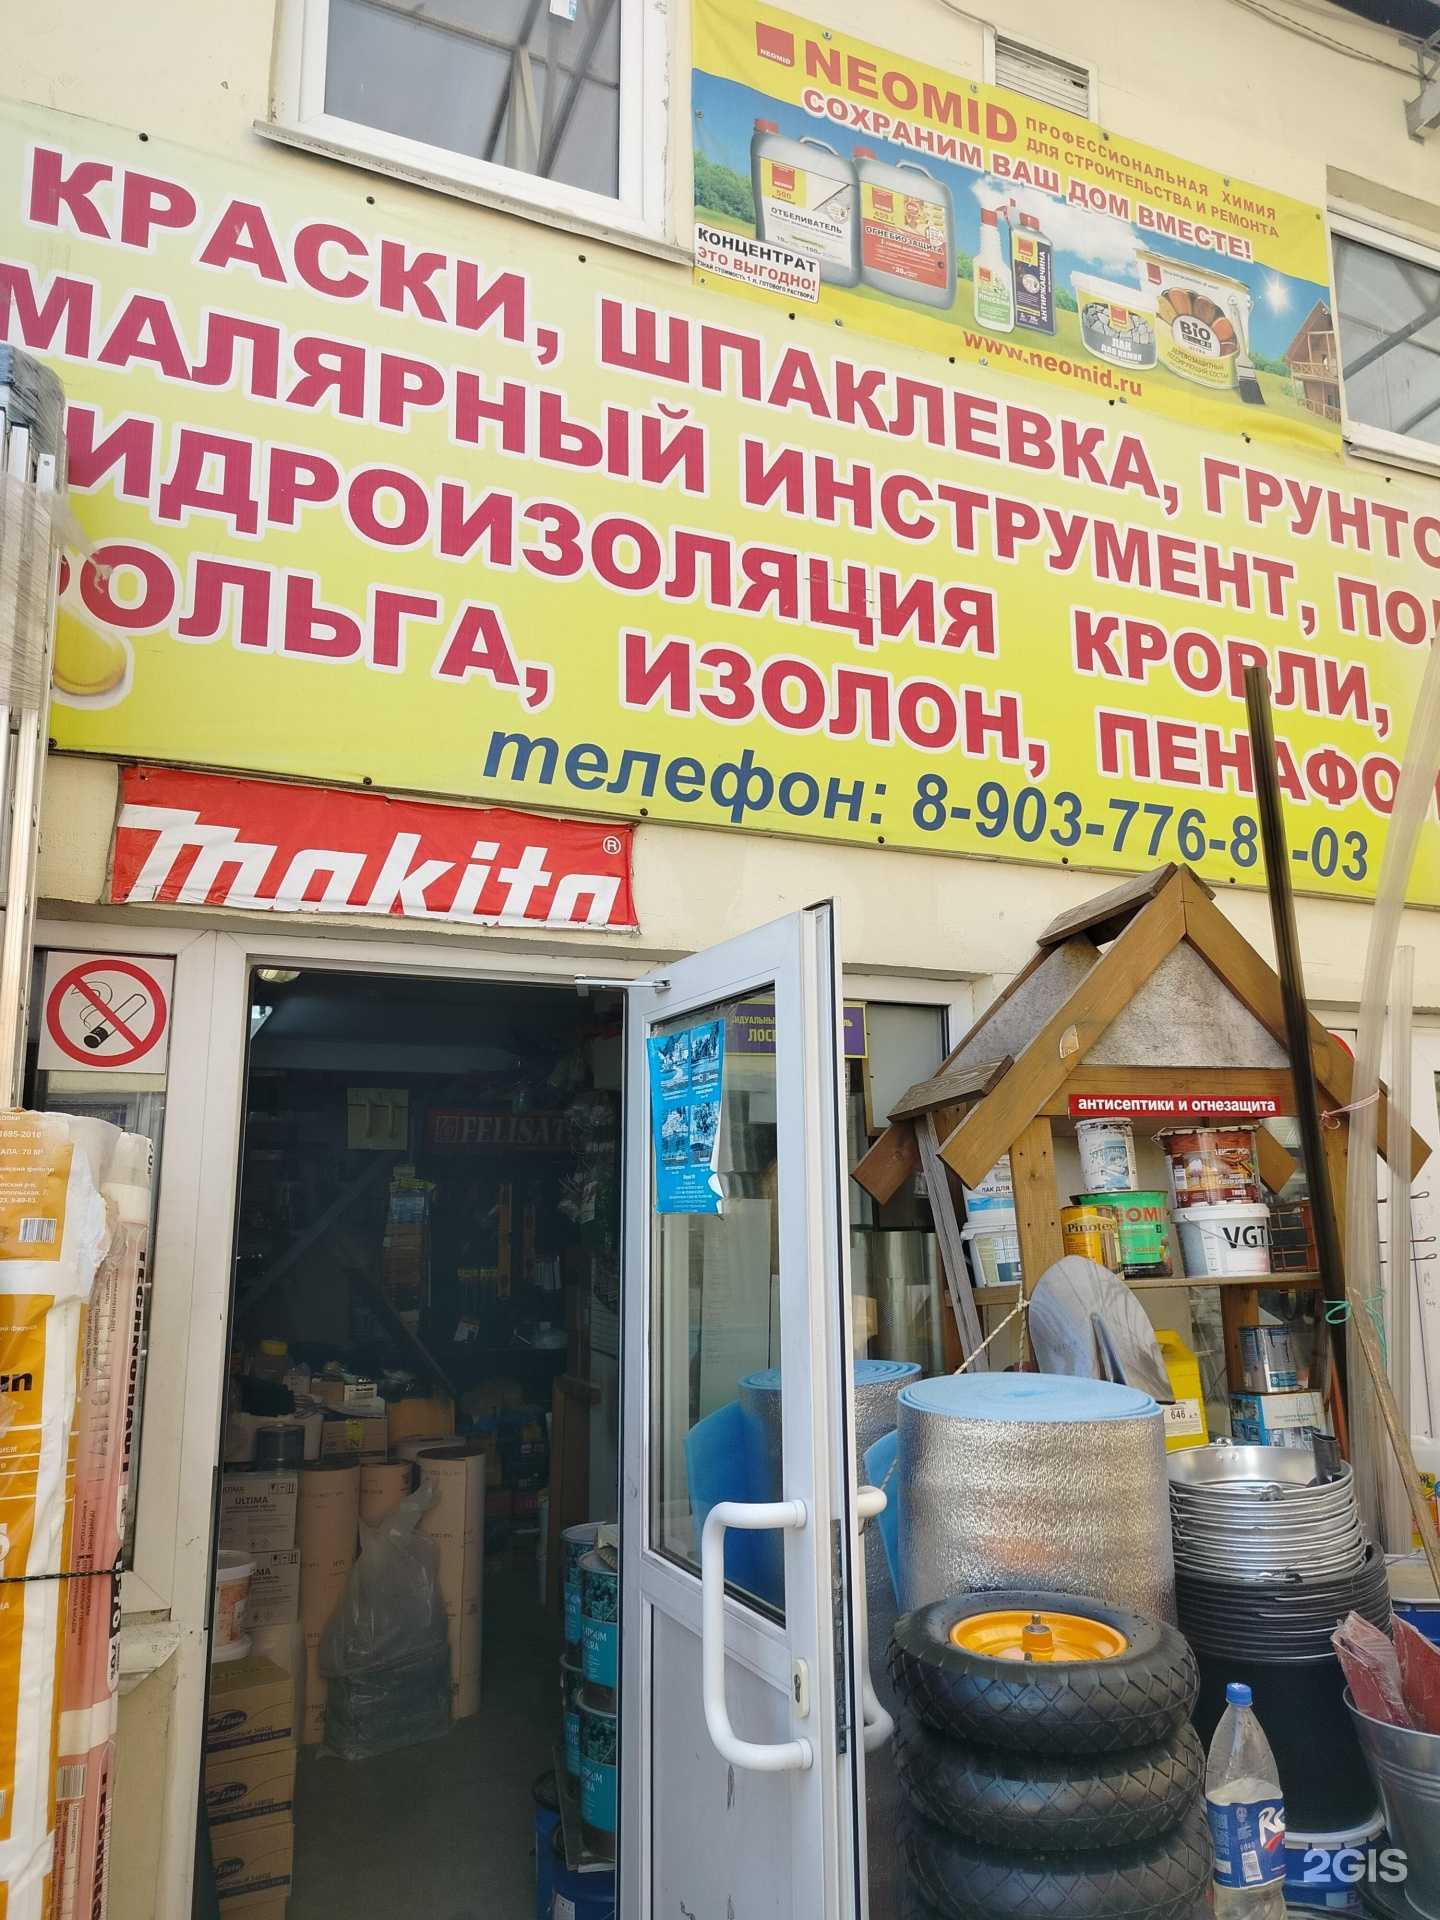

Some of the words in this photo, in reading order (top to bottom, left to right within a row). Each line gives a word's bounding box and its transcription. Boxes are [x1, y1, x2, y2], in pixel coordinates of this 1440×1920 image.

[804, 39, 1018, 144] NEOMID
[803, 89, 982, 169] СОХРАНИМ
[992, 153, 1060, 195] ВАШ
[1068, 179, 1130, 220] ДОМ
[1138, 204, 1252, 260] ВМЕСТЕ!
[1026, 116, 1209, 197] ПРОФЕССИОНАЛЬНАЯ
[1221, 190, 1277, 221] ХИМИЯ
[1026, 137, 1059, 161] ДЛЯ
[1064, 151, 1192, 210] СТРОИТЕЛЬСТВА
[1195, 202, 1206, 215] И
[1211, 205, 1280, 238] РЕМОНТА
[697, 246, 728, 266] ЭТО
[733, 257, 816, 292] ВЫГОДНО!
[698, 227, 817, 273] КОНЦЕНТРАТ
[770, 206, 843, 234] ОТБЕЛИВАТЕЛЬ
[28, 146, 559, 366] КРАСКИ,
[601, 298, 1179, 516] ШПАКЛЕВКА,
[963, 331, 1142, 397] www.neomid.ru
[0, 262, 705, 494] МАЛЯРНЫЙ
[742, 439, 1317, 636] ИНСТРУМЕНТ,
[1338, 576, 1440, 645] ПО
[66, 405, 997, 656] ИДРОИЗОЛЯЦИЯ
[1073, 610, 1392, 738] КРОВЛИ,
[59, 543, 549, 709] ОЛЬГА,
[622, 632, 1046, 779] ИЗОЛОН,
[1098, 711, 1440, 821] ПЕНАФО
[483, 731, 887, 824] телефон:
[911, 772, 1370, 882] 8-903-776-8-03
[1078, 1097, 1174, 1112] антисептики
[1179, 1099, 1188, 1112] и
[1191, 1099, 1277, 1114] огнезащита
[1222, 1224, 1266, 1249] VGT
[1170, 1410, 1186, 1420] 646
[235, 1496, 269, 1506] ULTIMA
